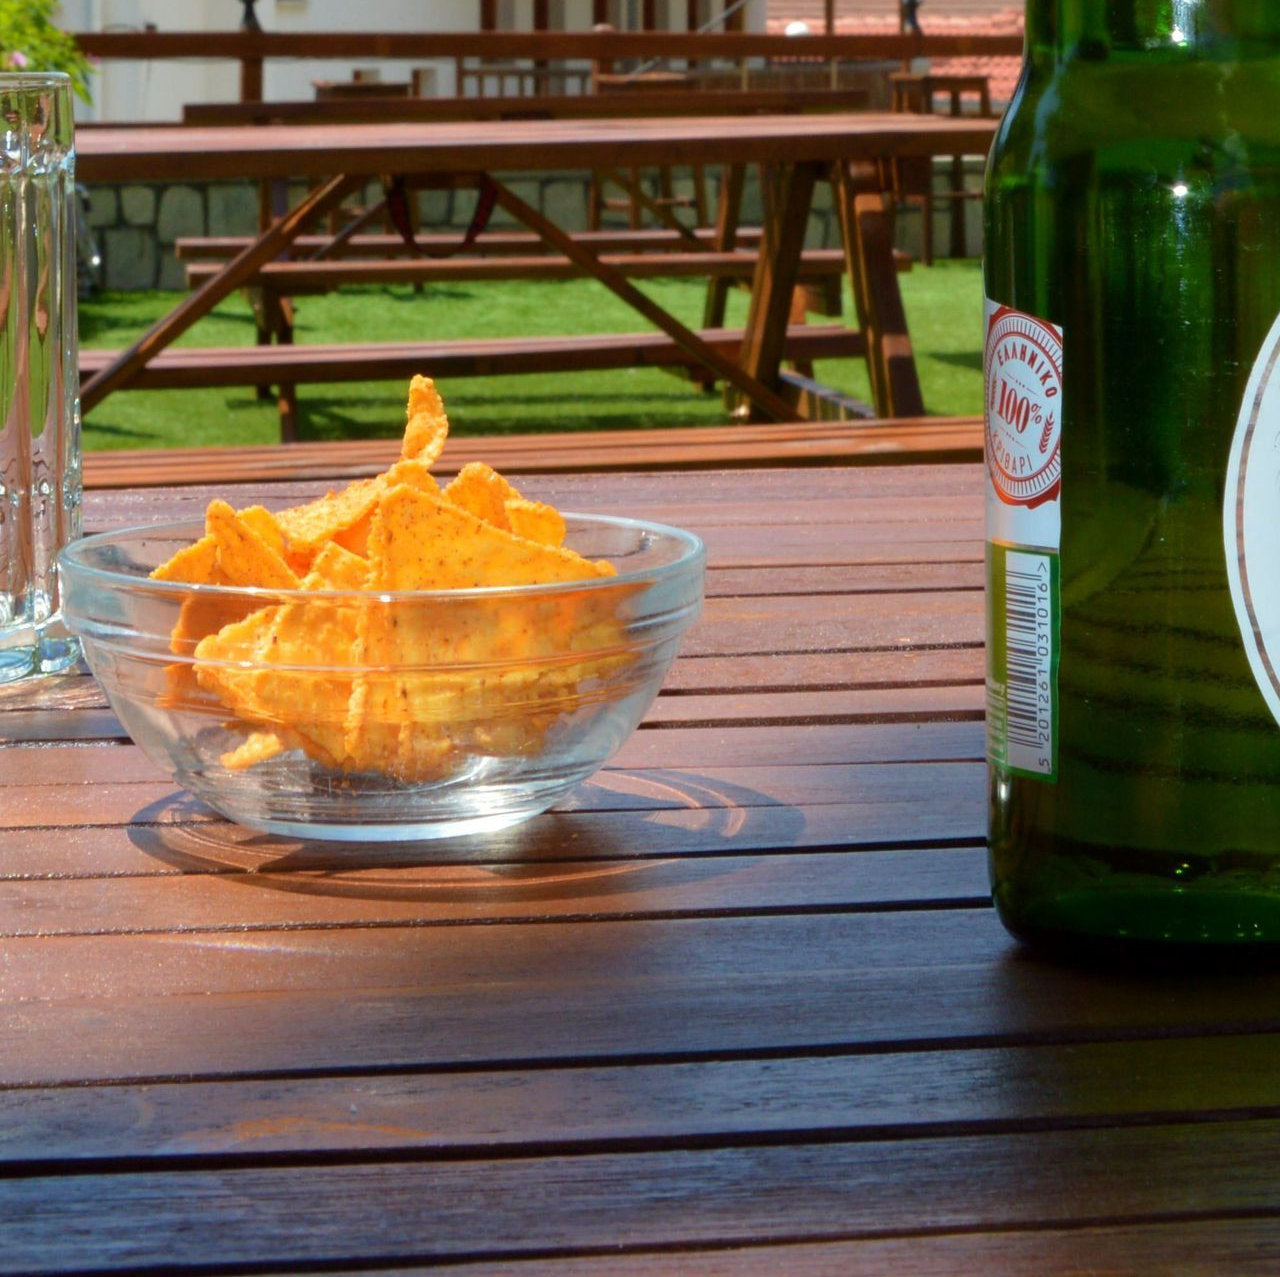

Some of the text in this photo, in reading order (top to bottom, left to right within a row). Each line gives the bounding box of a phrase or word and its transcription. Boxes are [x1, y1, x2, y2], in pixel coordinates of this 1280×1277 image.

[997, 342, 1058, 399] ΕΛΛΗΝΙΚΟ
[998, 378, 1042, 434] 100%
[992, 430, 1033, 475] ΚΡΙΘΑΡΙ
[1037, 582, 1049, 657] 031016
[1038, 669, 1050, 742] 201261
[1038, 757, 1050, 768] 5
